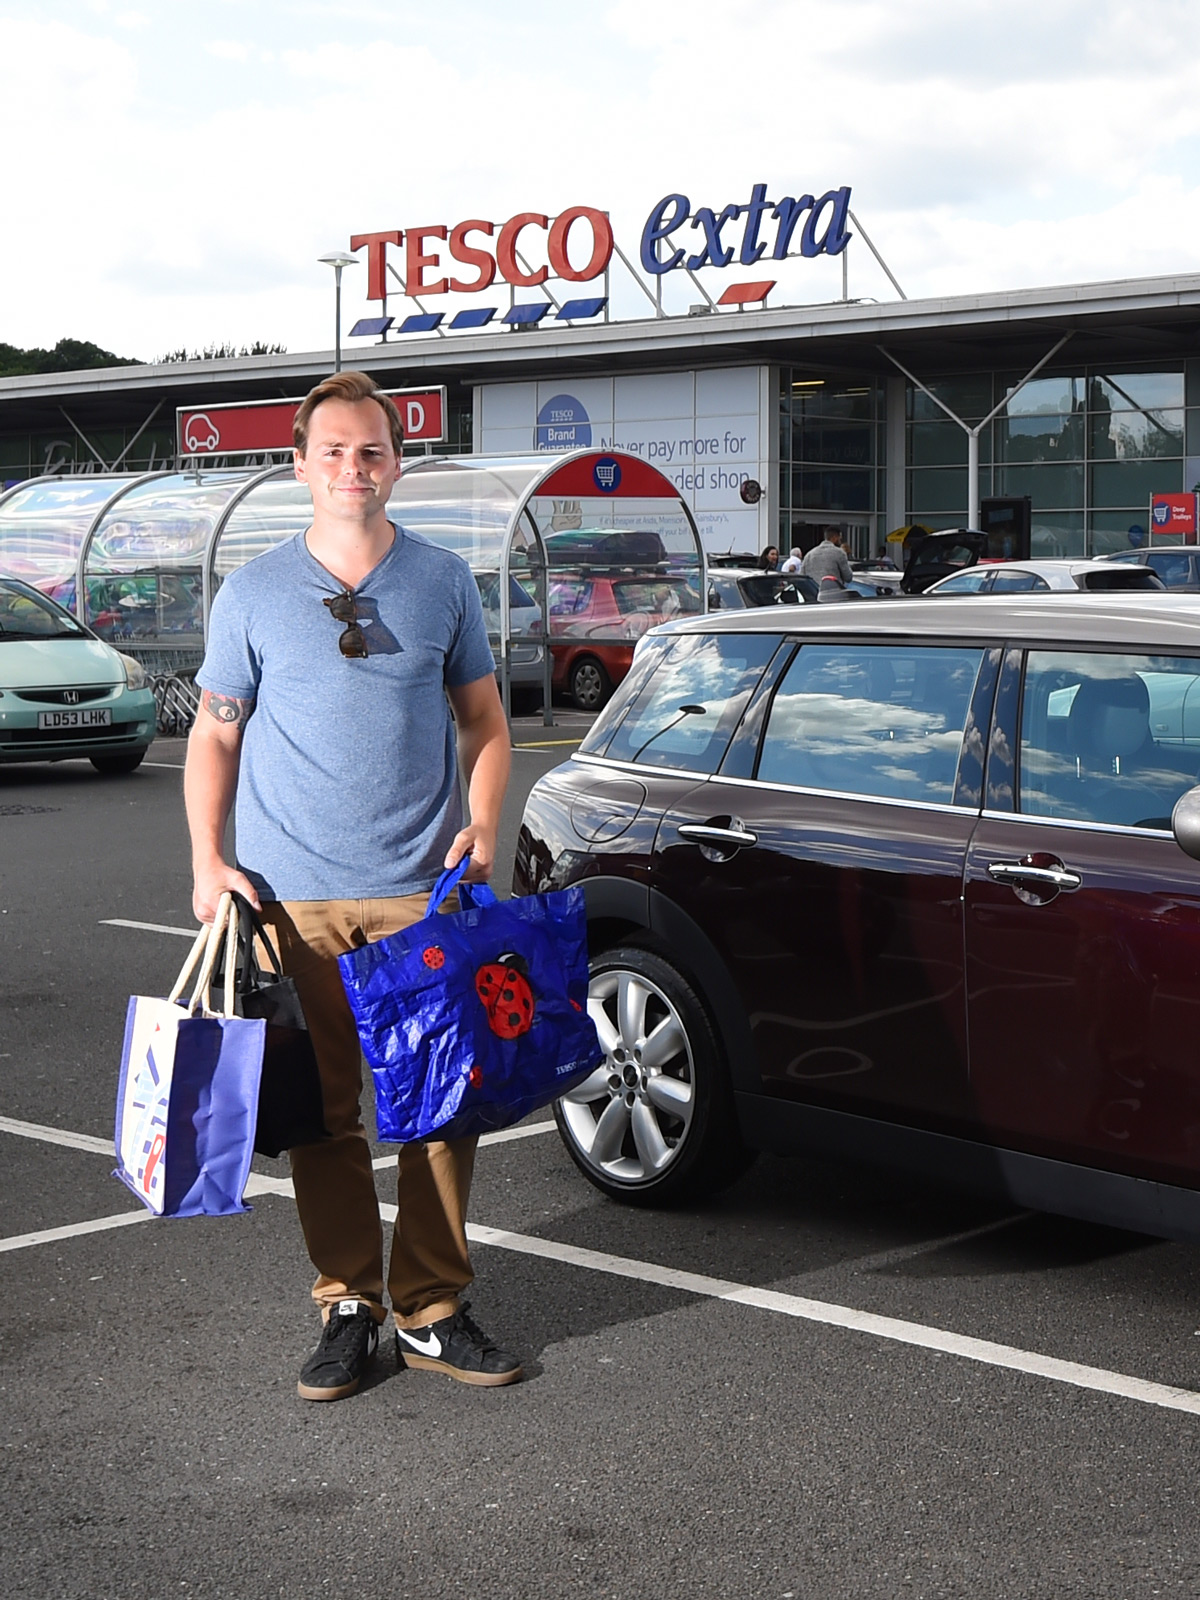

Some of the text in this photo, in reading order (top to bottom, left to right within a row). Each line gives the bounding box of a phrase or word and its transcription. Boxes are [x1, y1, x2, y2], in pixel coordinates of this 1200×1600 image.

[350, 183, 853, 301] TESCO extra
[407, 401, 426, 433] D
[550, 409, 574, 419] TESCO
[548, 426, 576, 441] Brand
[648, 438, 676, 461] pay
[679, 435, 719, 455] more
[724, 430, 747, 453] for
[710, 466, 750, 490] shop
[1172, 513, 1192, 521] Trolleys
[44, 710, 106, 727] LD53 LHK
